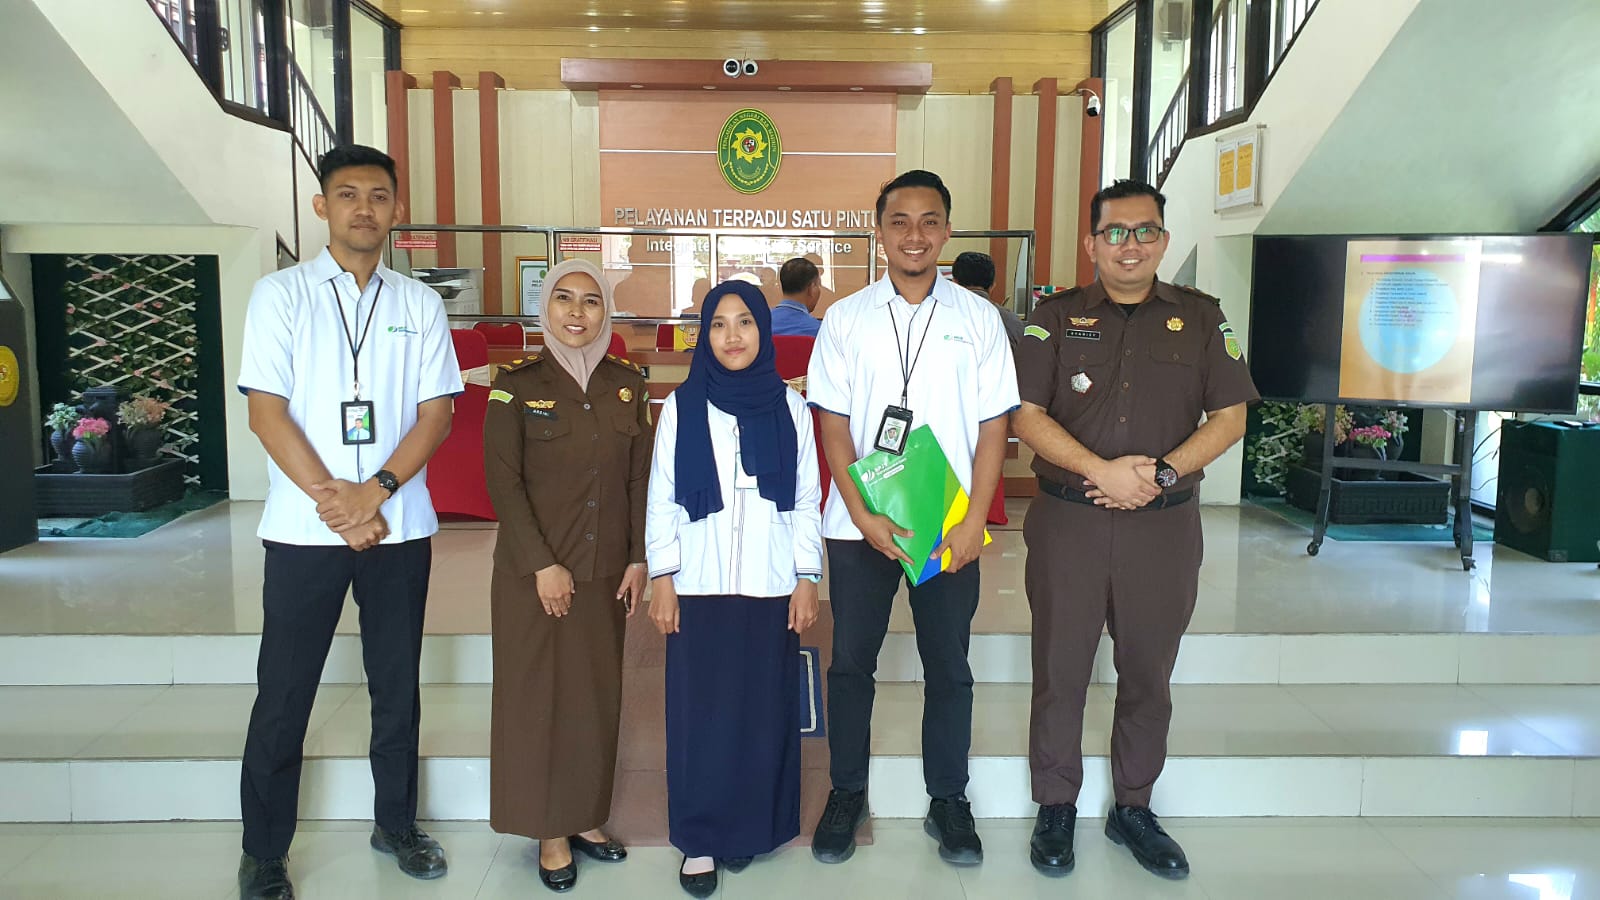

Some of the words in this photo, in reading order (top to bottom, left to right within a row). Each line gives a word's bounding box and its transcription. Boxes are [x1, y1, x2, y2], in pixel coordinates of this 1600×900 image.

[722, 117, 739, 150] PENGADILAN
[738, 112, 760, 120] NEGERI
[614, 207, 708, 226] PELAYANAN
[712, 209, 787, 227] TERPADU
[791, 209, 832, 228] SATU
[646, 237, 711, 254] Integrate
